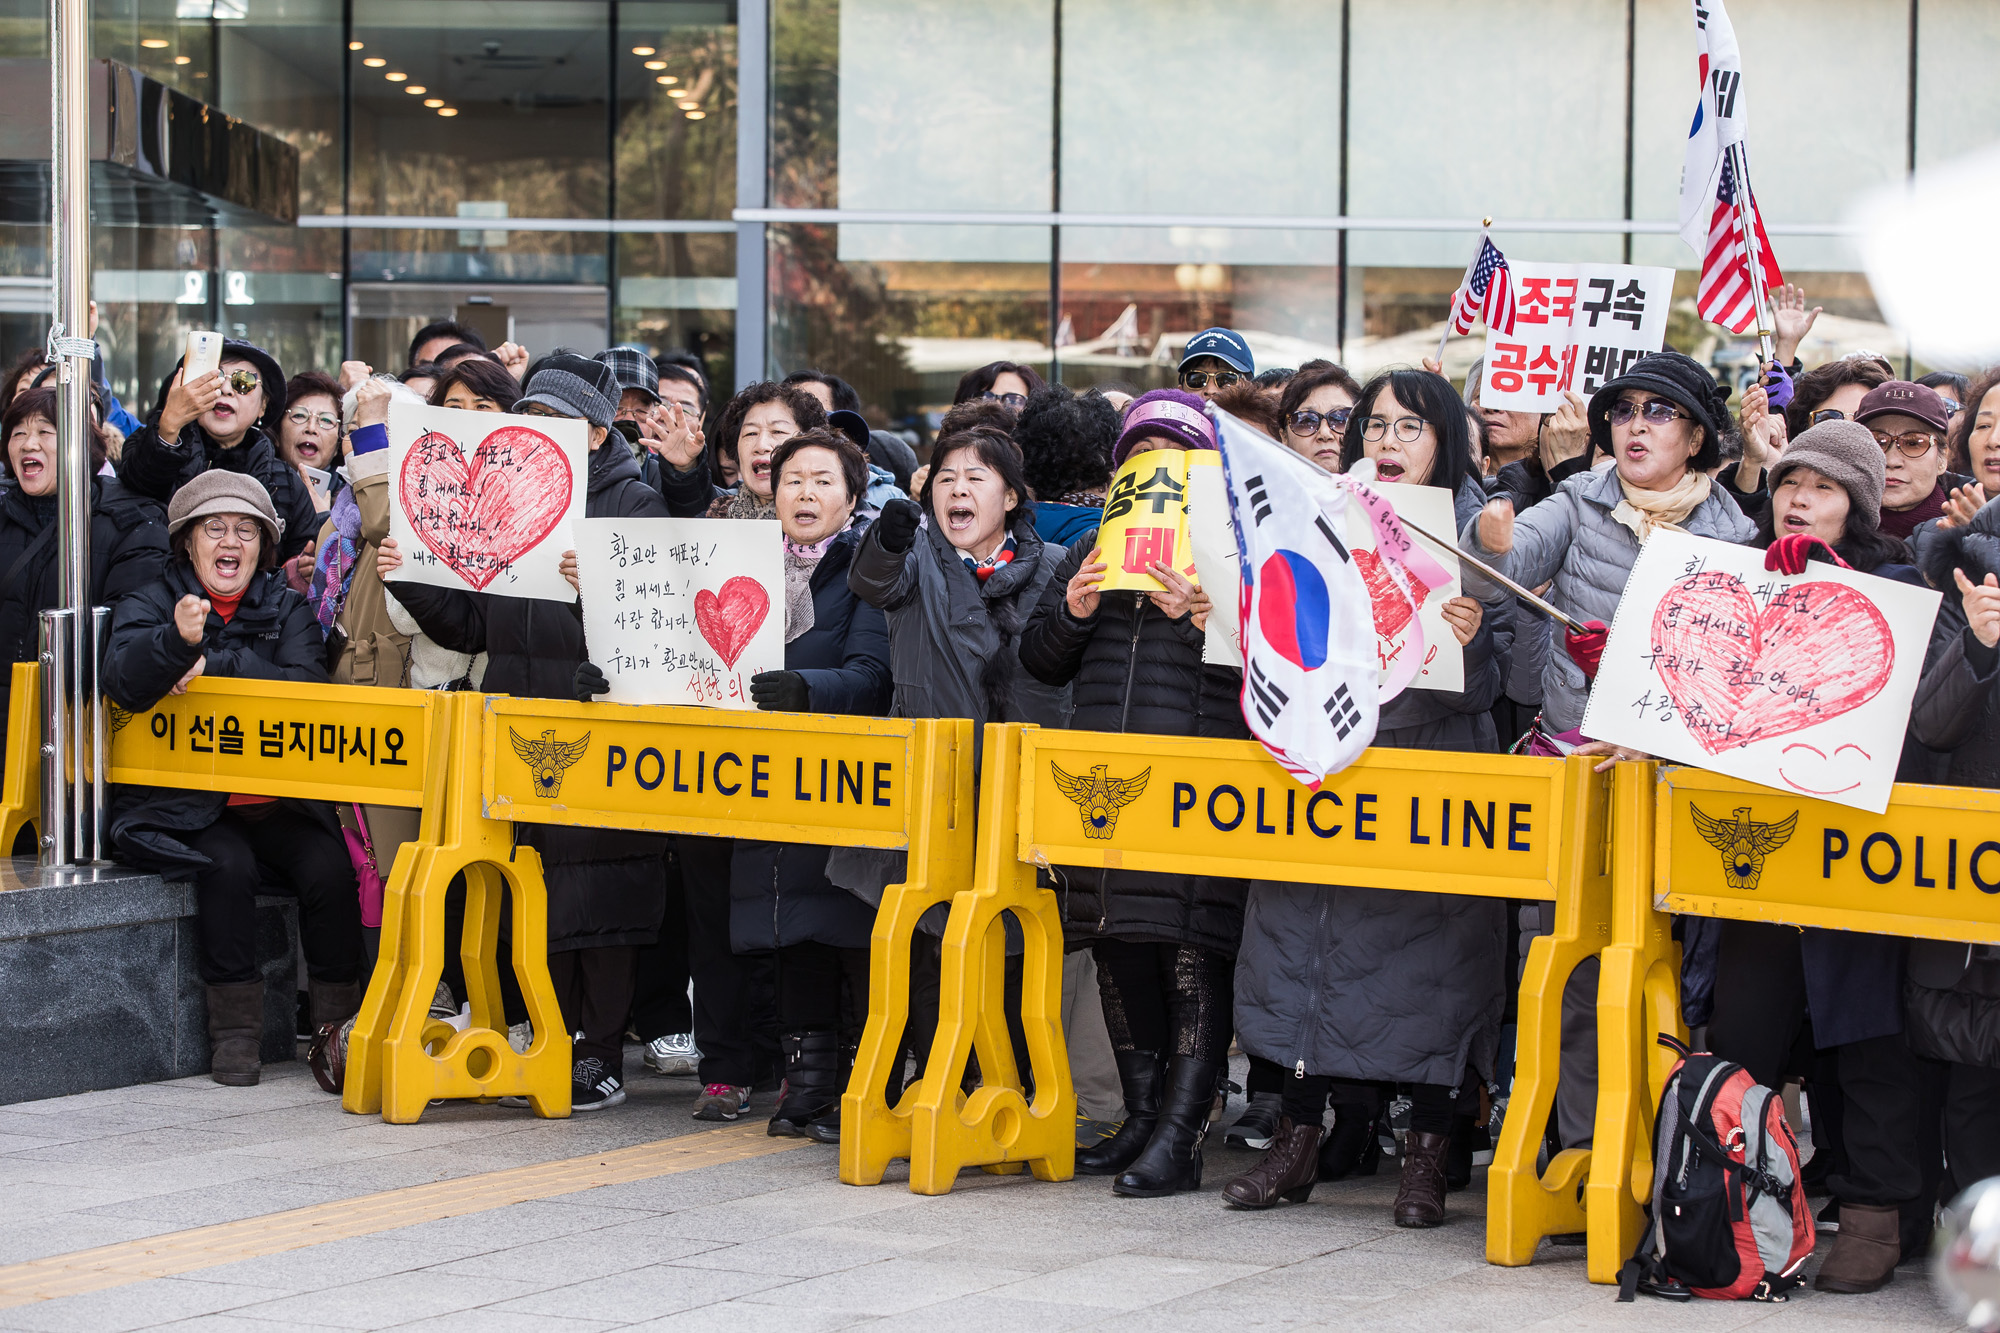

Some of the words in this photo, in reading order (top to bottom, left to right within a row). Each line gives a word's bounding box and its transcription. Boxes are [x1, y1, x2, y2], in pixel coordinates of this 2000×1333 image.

[1516, 277, 1579, 327] 조국
[1581, 278, 1646, 331] 구속
[420, 427, 466, 465] 황교안
[418, 475, 428, 498] 힘
[1103, 467, 1191, 526] 공수
[413, 550, 437, 566] 내가
[610, 532, 657, 567] 황교안
[615, 579, 625, 601] 힘
[1674, 554, 1746, 594] 황교안
[1663, 602, 1683, 630] 힘
[607, 647, 650, 674] 우리가
[1640, 645, 1704, 676] 우리가
[151, 712, 175, 751] 이
[189, 714, 245, 756] 선을
[259, 719, 408, 767] 넘지마시오
[606, 744, 770, 799] POLICE
[794, 756, 892, 807] LINE
[1172, 781, 1378, 842] POLICE
[1409, 795, 1532, 853] LINE
